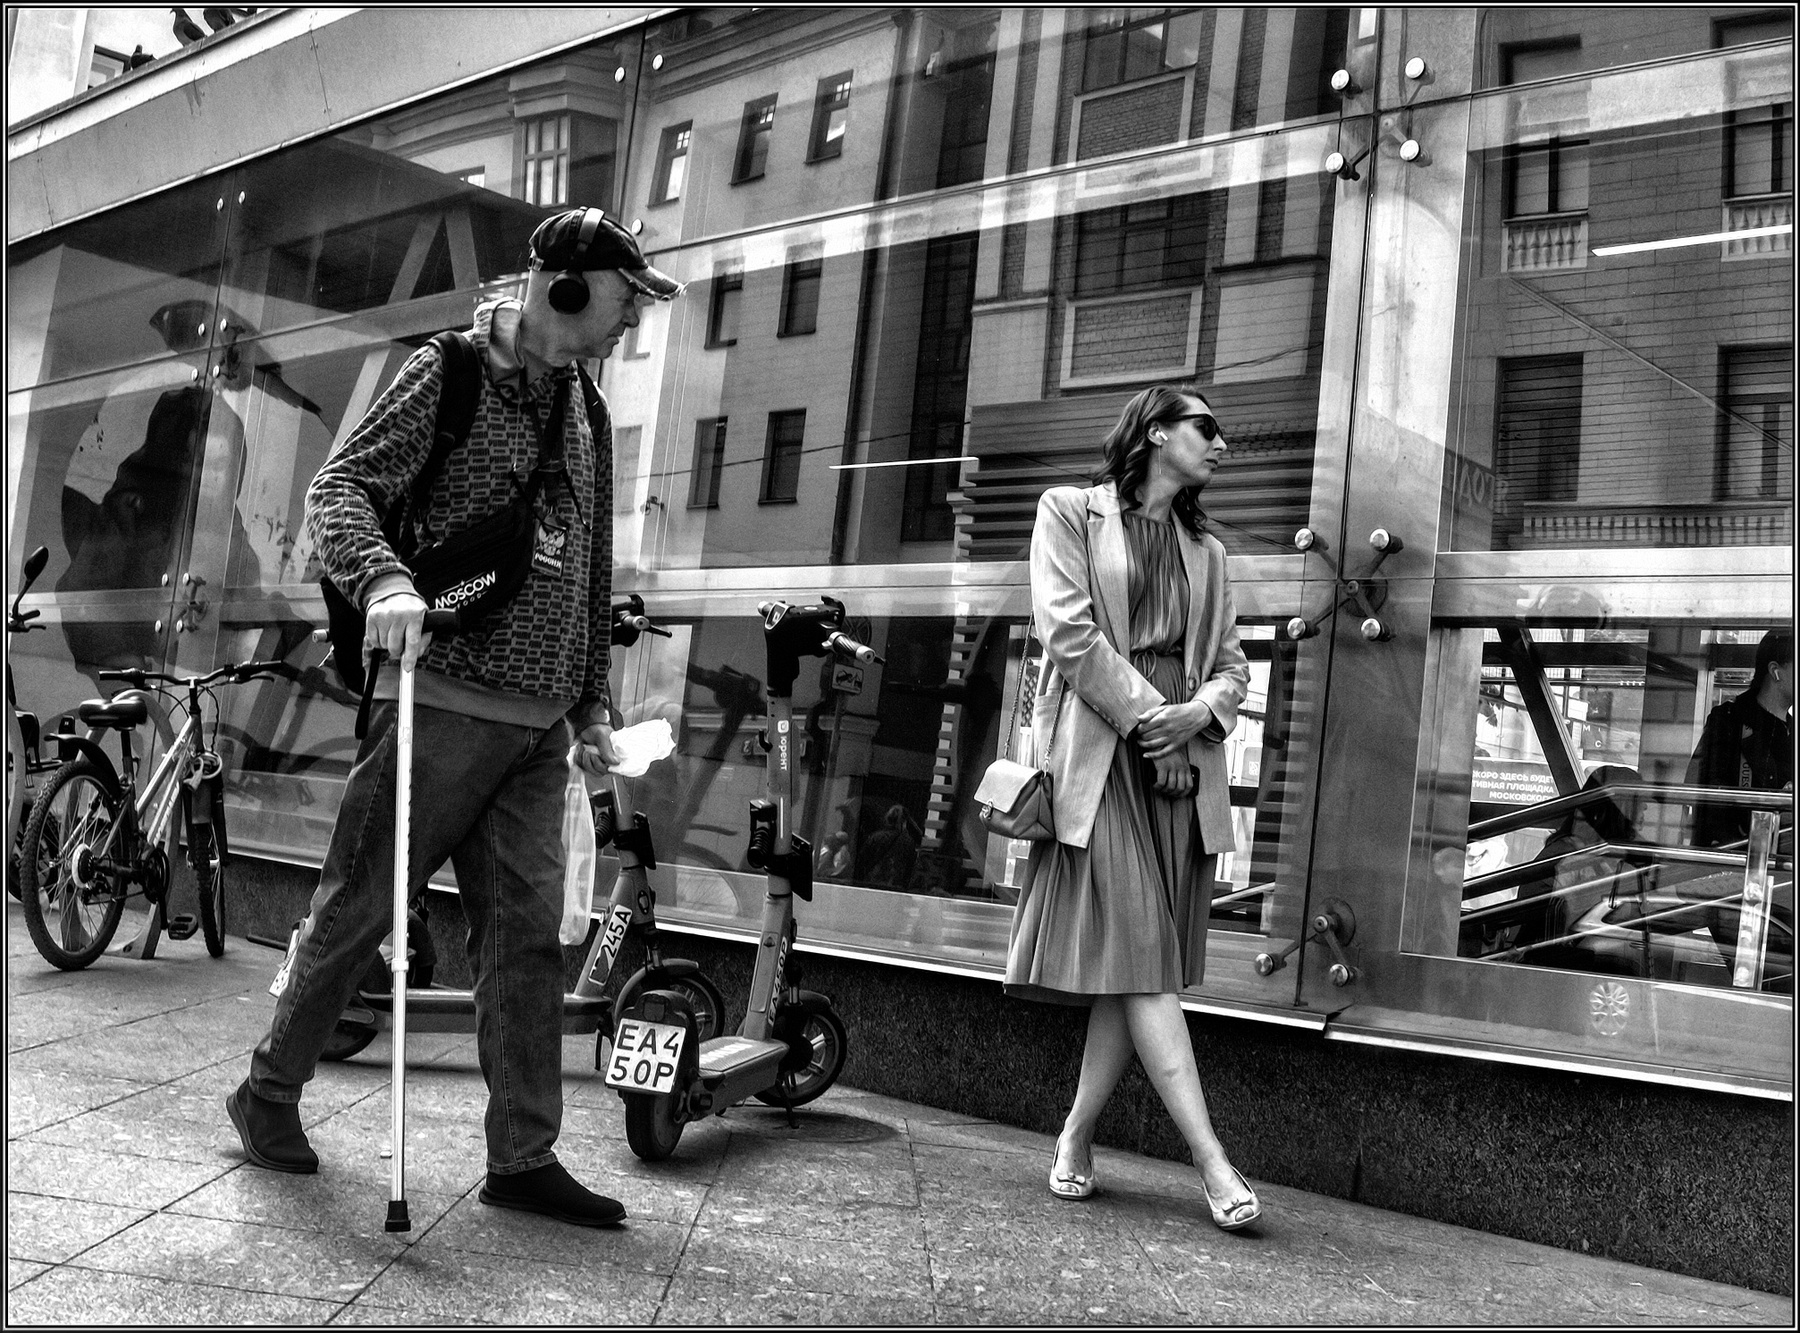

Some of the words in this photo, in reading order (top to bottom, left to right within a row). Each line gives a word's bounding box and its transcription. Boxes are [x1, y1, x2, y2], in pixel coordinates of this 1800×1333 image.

[435, 570, 496, 609] MOSCOW
[1499, 772, 1529, 782] ЗДЕСЬ
[1506, 783, 1554, 793] ПЛОЩАДКА
[616, 1024, 679, 1058] EA4
[611, 1056, 674, 1087] 50P
